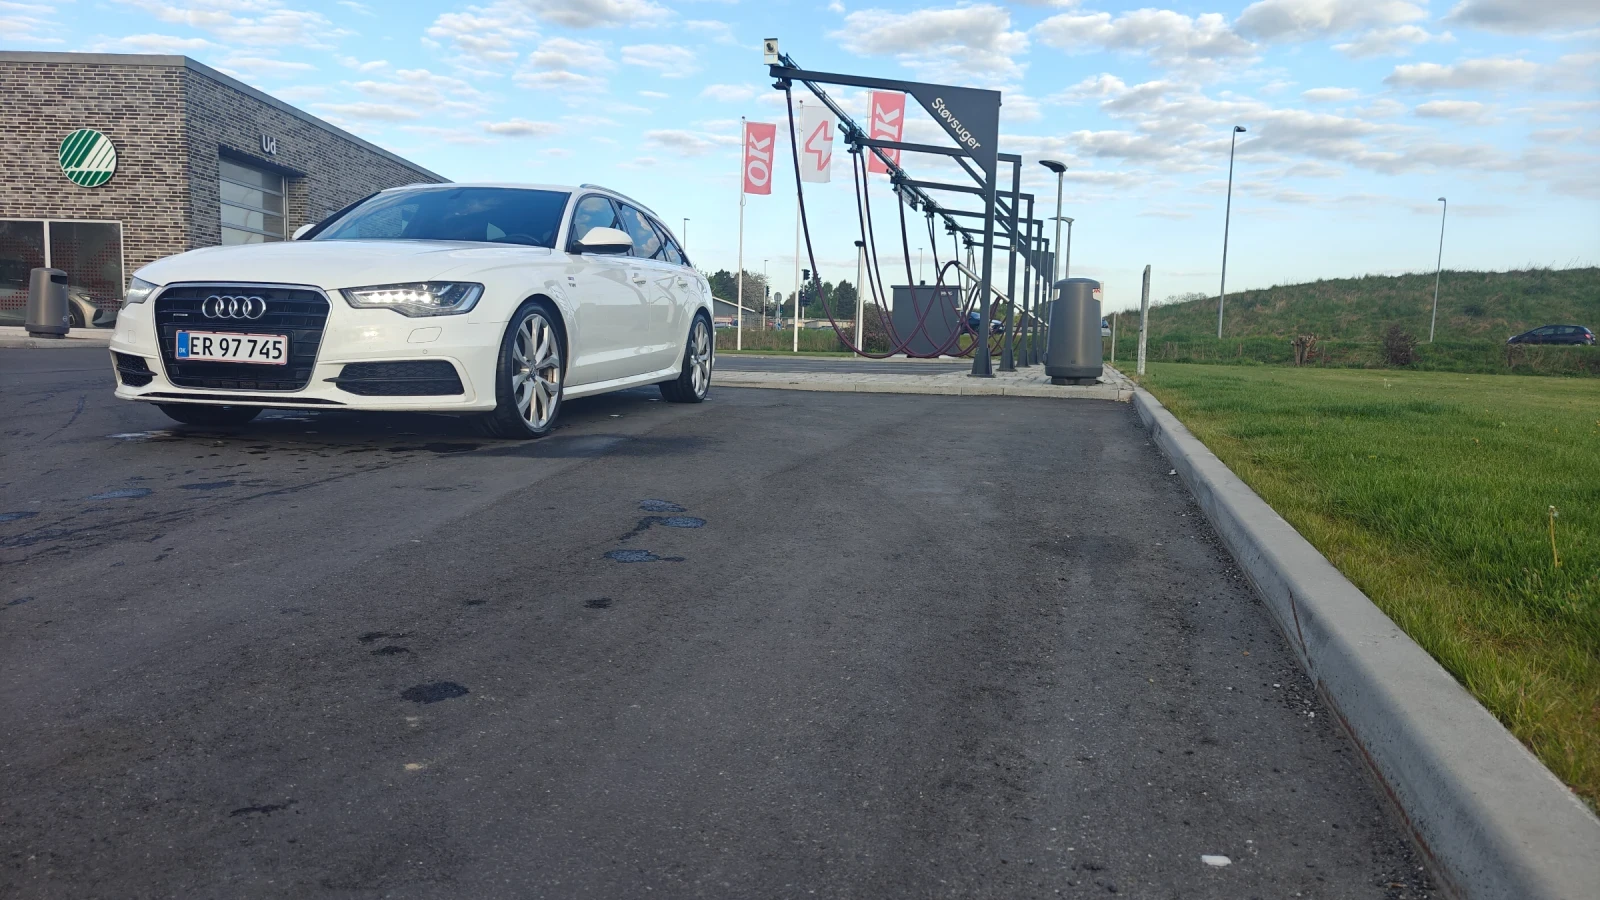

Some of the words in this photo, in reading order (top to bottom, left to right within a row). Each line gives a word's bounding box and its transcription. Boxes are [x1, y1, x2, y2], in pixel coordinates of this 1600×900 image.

[931, 97, 981, 150] Støvsuger
[262, 134, 277, 155] Ud
[747, 132, 771, 187] OK
[190, 336, 214, 357] ER
[219, 337, 242, 357] 97
[247, 339, 283, 360] 745
